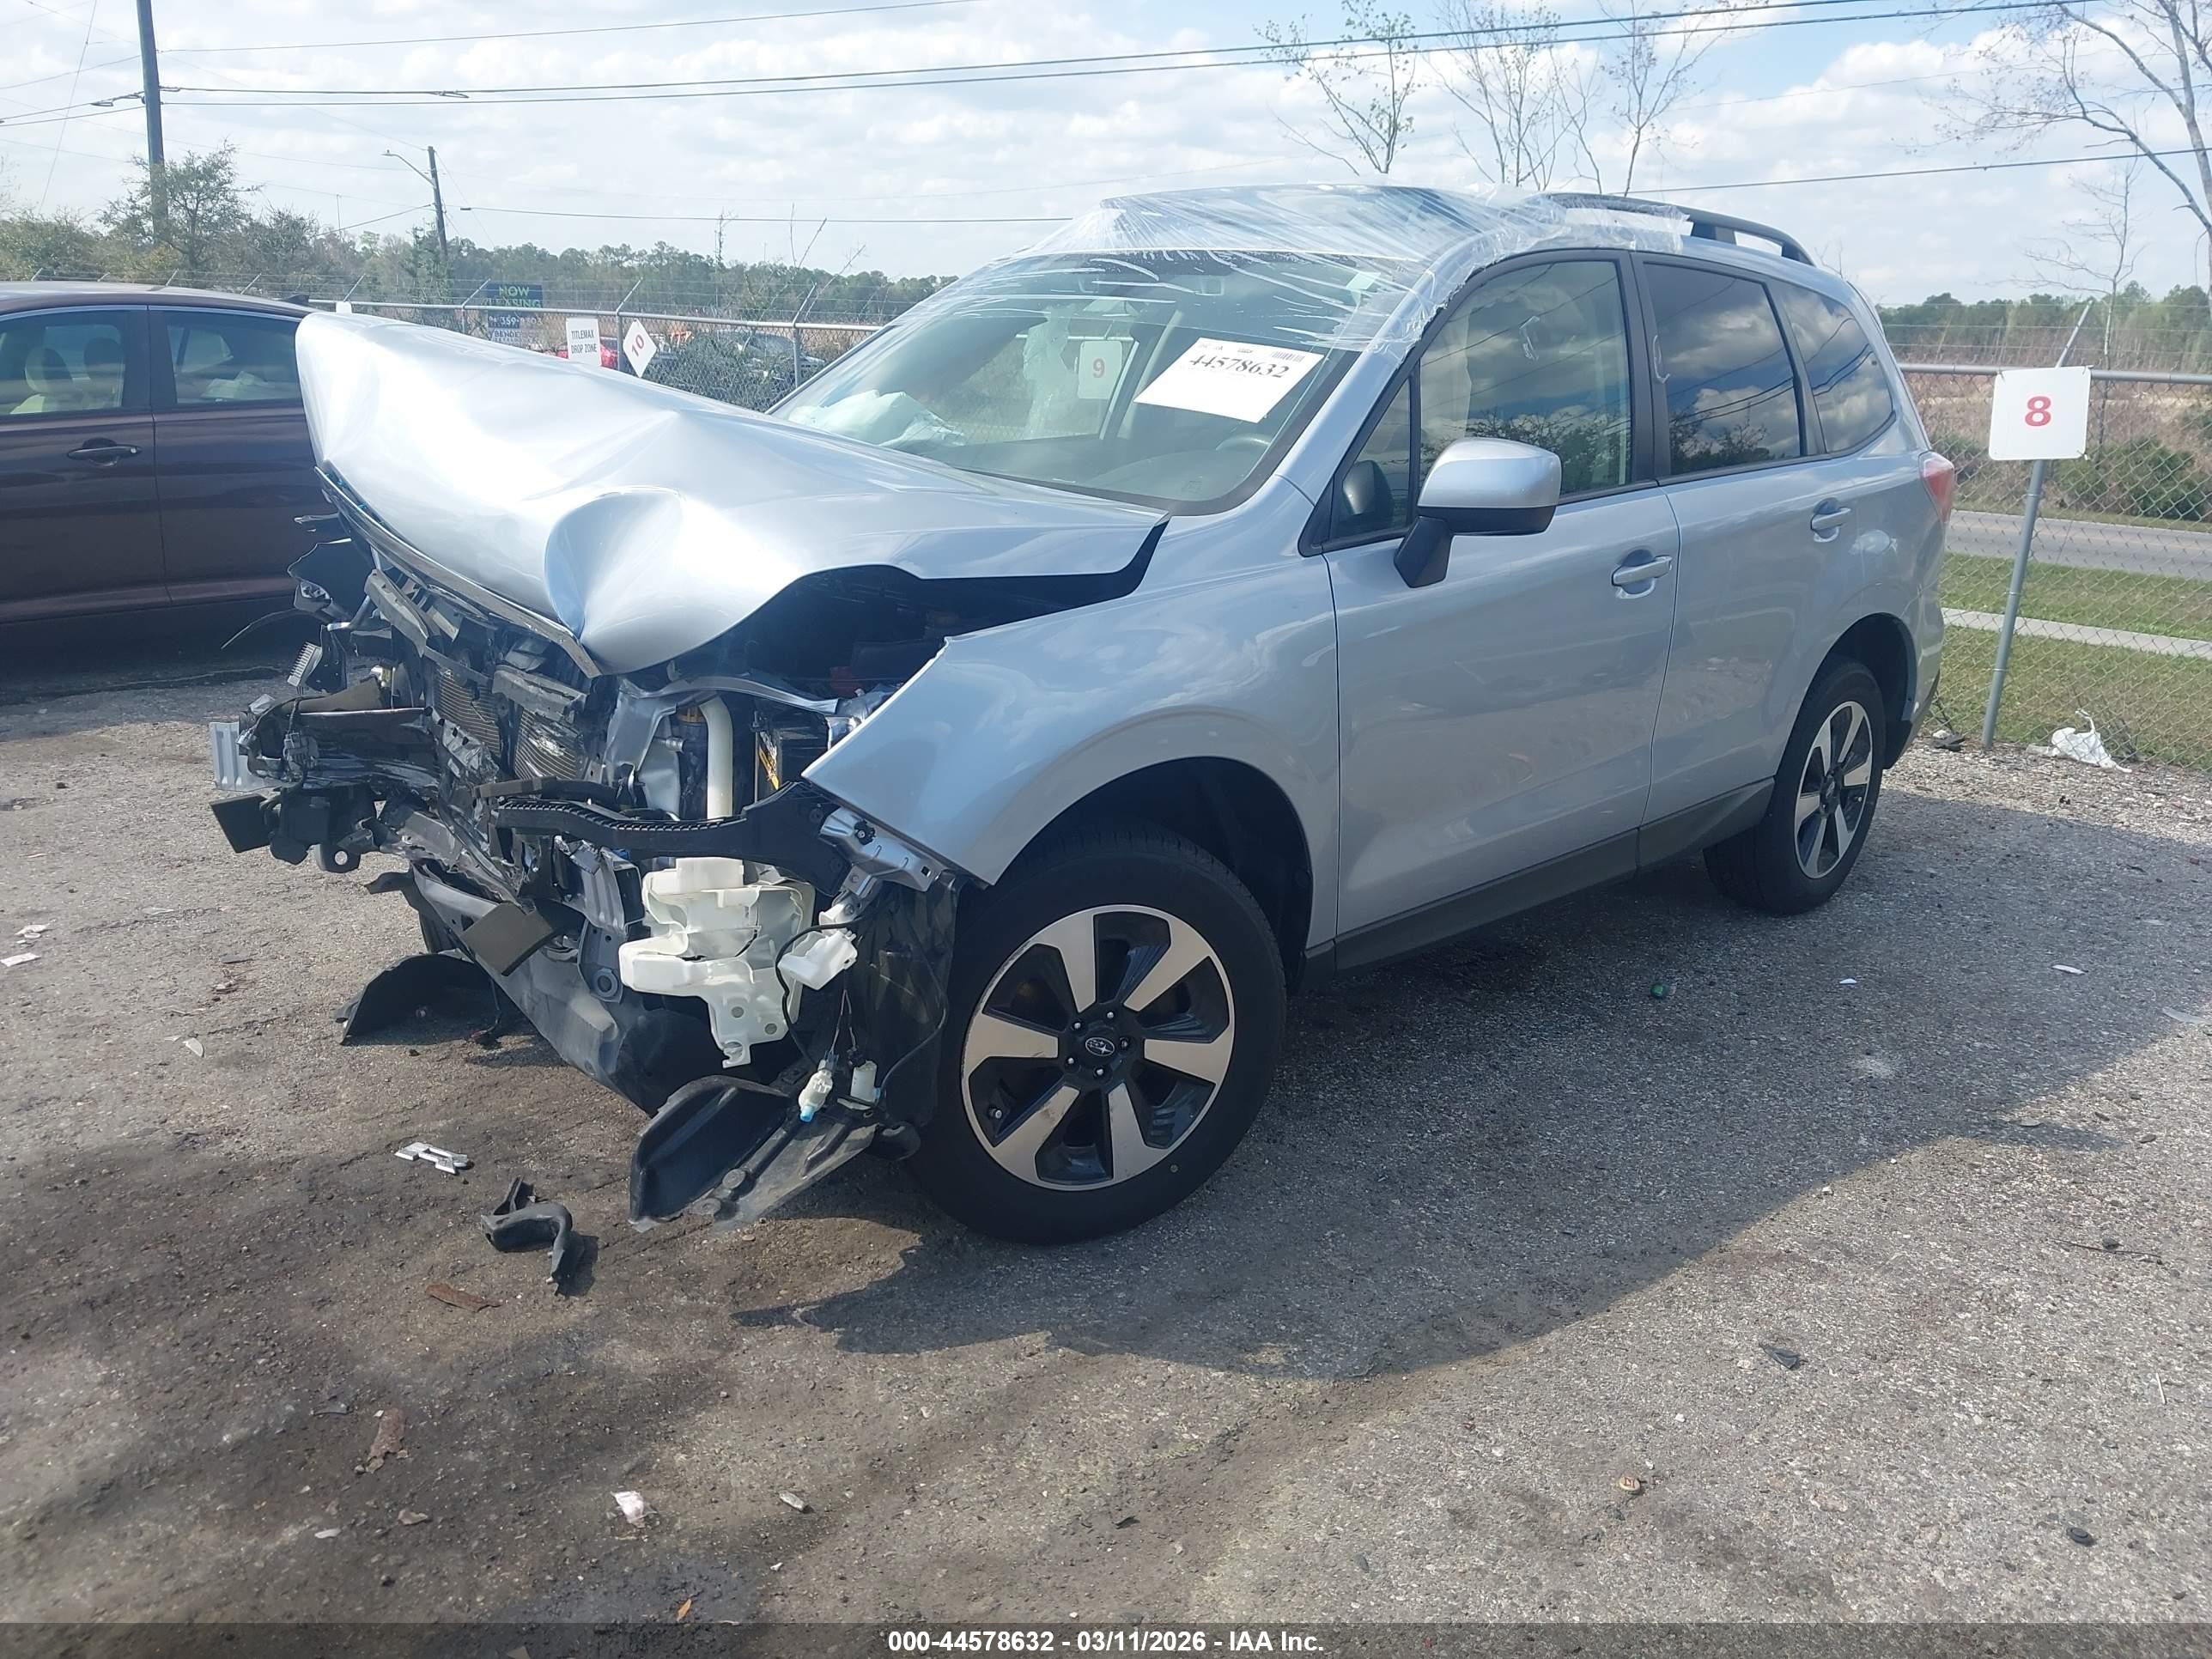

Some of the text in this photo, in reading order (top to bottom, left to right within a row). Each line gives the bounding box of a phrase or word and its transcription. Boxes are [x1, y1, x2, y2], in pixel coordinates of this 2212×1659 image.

[499, 286, 530, 297] NOW
[489, 298, 541, 308] LEASING
[571, 330, 594, 339] TITLEMAX
[571, 343, 598, 354] DROP ZONE
[631, 334, 645, 357] 10
[1093, 358, 1105, 379] 9
[1190, 355, 1290, 379] 44578632
[2025, 396, 2051, 427] 8
